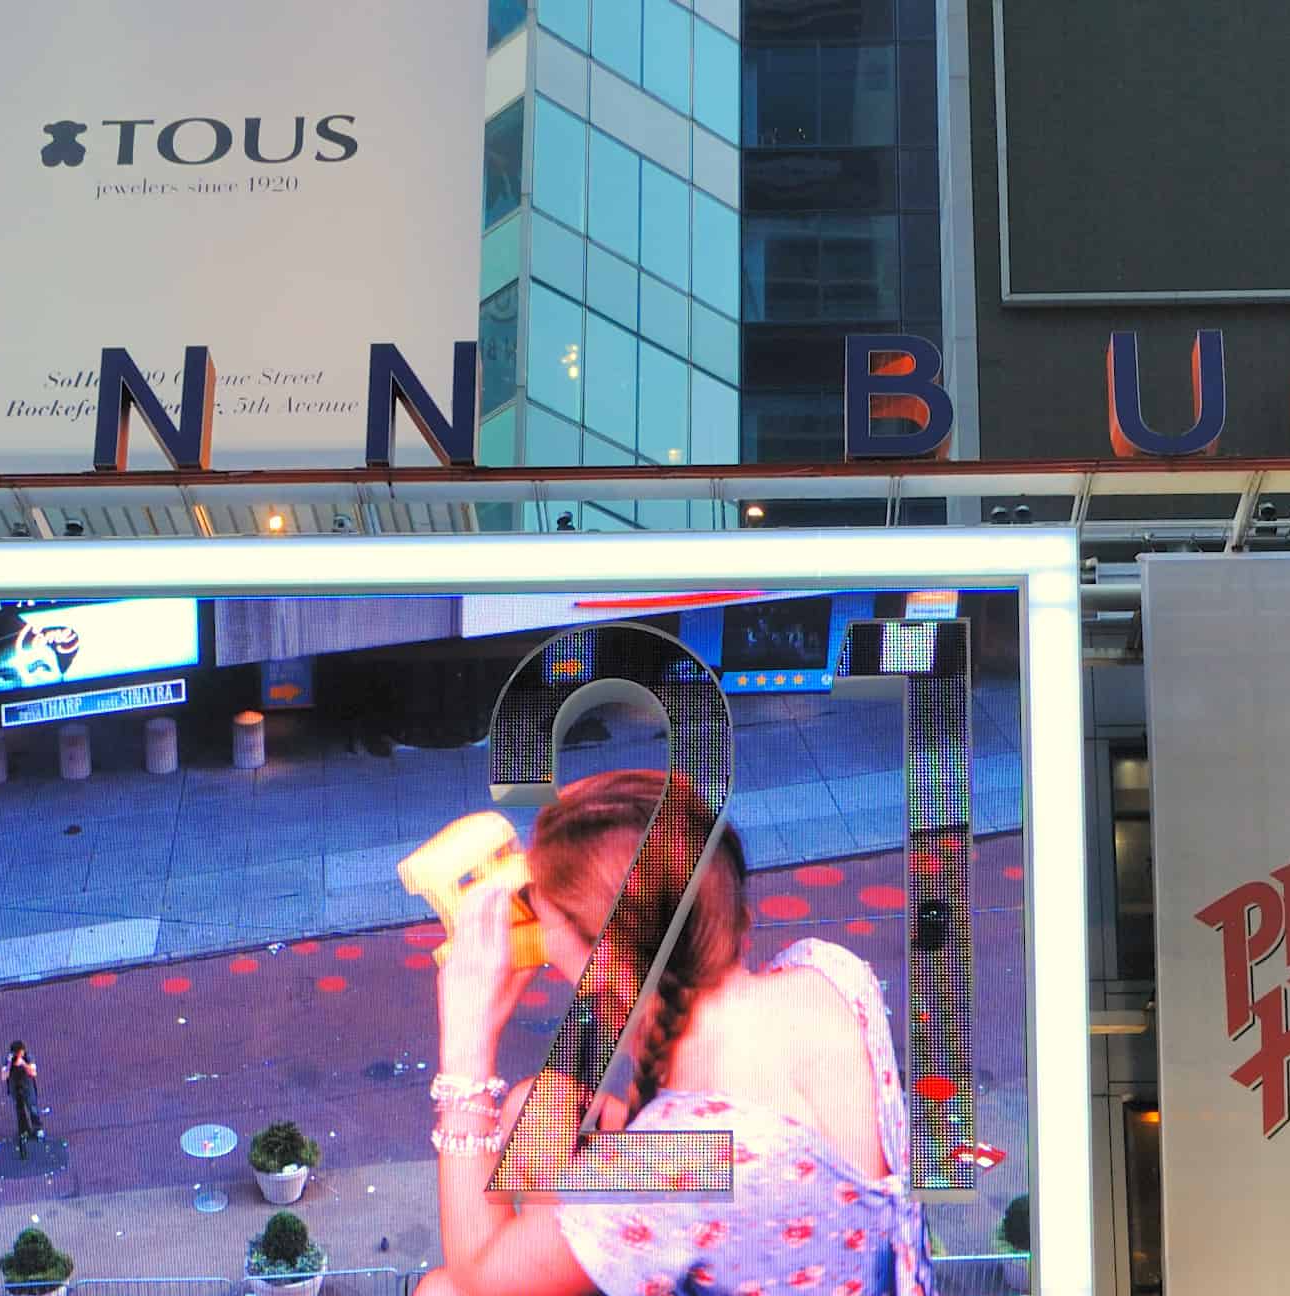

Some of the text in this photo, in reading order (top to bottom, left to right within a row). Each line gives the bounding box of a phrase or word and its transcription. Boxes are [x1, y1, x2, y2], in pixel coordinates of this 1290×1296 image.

[102, 115, 358, 165] TOUS
[95, 176, 299, 200] jewelers since 1920
[258, 369, 325, 386] Street
